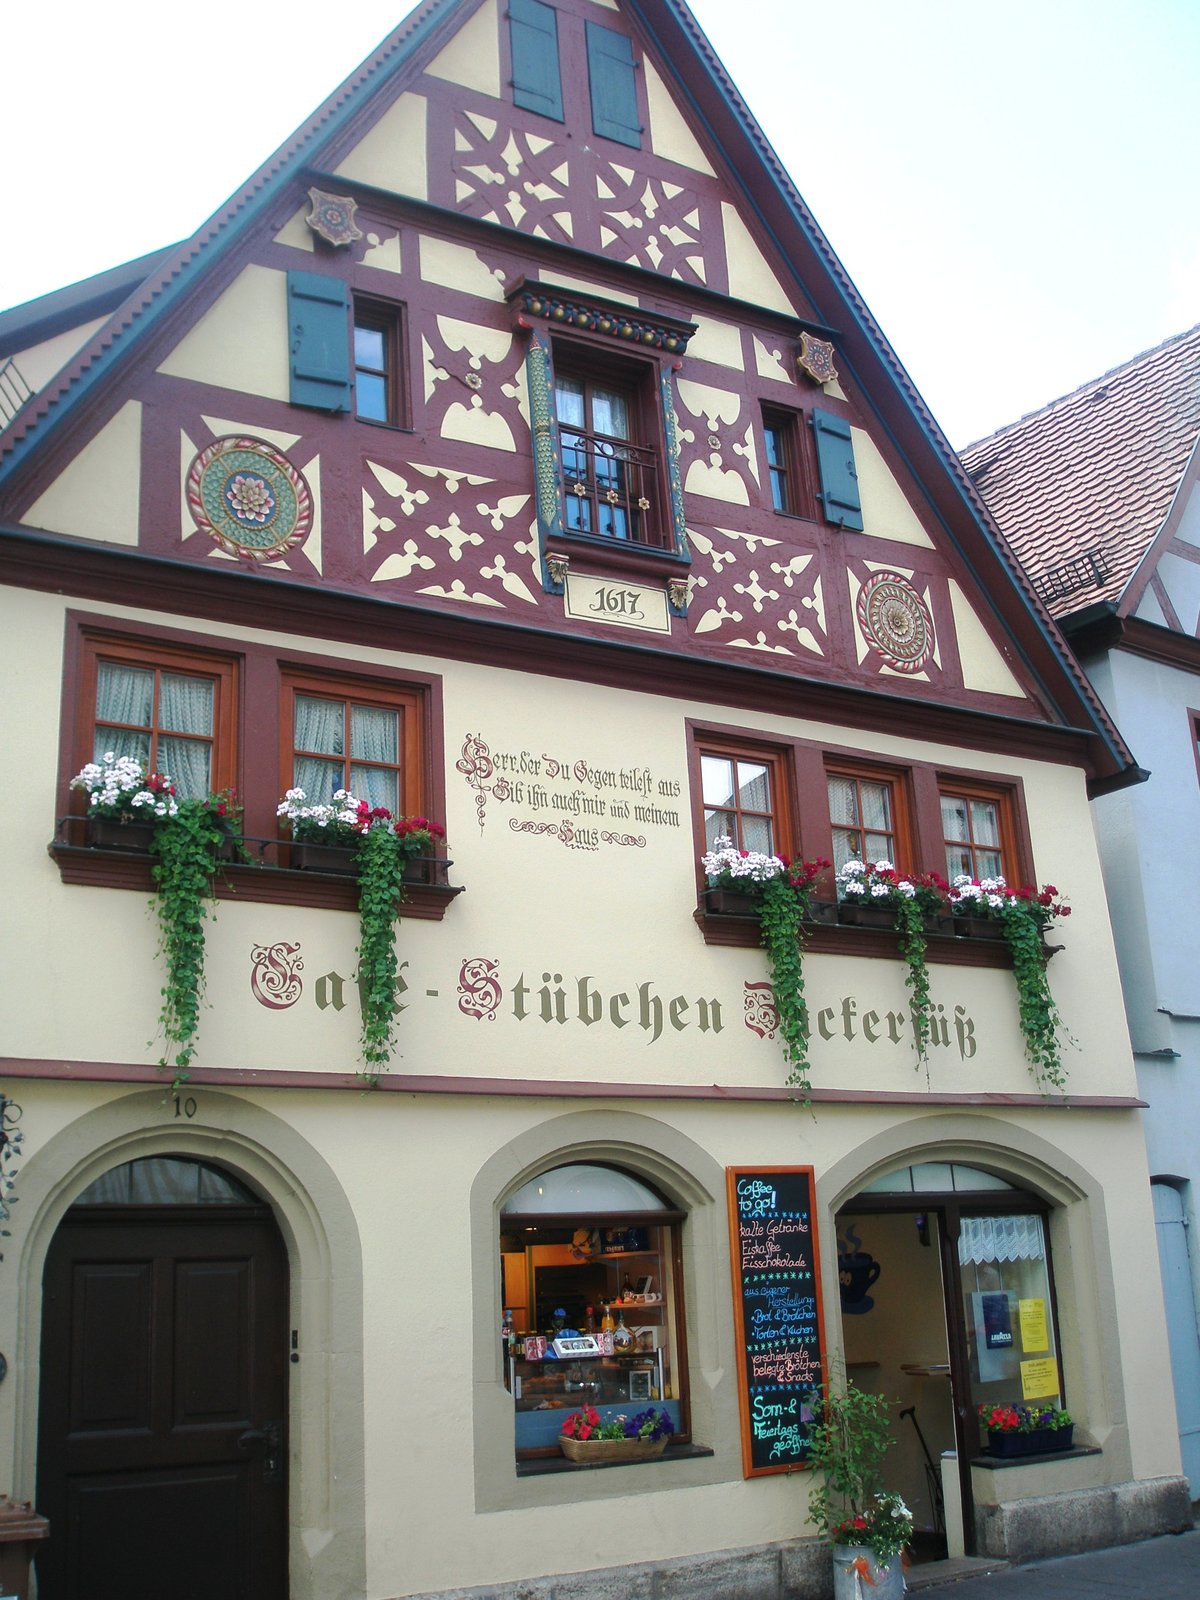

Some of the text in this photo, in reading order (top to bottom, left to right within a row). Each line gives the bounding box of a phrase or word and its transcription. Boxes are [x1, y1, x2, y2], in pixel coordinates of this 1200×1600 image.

[589, 587, 642, 614] 1617
[520, 751, 541, 777] der
[542, 754, 571, 781] Du
[658, 779, 681, 798] aus
[492, 777, 524, 804] Gib
[551, 790, 583, 816] auch
[582, 795, 606, 816] mir
[610, 800, 630, 819] und
[634, 802, 681, 828] meinem
[558, 819, 598, 847] Haus
[457, 958, 725, 1046] Stübchen
[173, 1096, 197, 1119] 10
[737, 1179, 774, 1199] Coffee
[738, 1196, 752, 1211] to
[739, 1218, 809, 1241] kalte Getränke
[742, 1239, 782, 1258] Eiskaffee
[742, 1252, 807, 1270] Eisschokolade
[744, 1282, 790, 1297] aus eigener
[754, 1309, 772, 1324] Brot
[782, 1308, 816, 1322] Brötchen
[754, 1325, 779, 1340] Torten
[787, 1324, 813, 1336] Kuchen
[751, 1343, 809, 1364] verschiedenste
[753, 1358, 821, 1379] belegte Brötchen
[753, 1419, 798, 1440] Feiertags
[769, 1435, 811, 1460] geöffne
